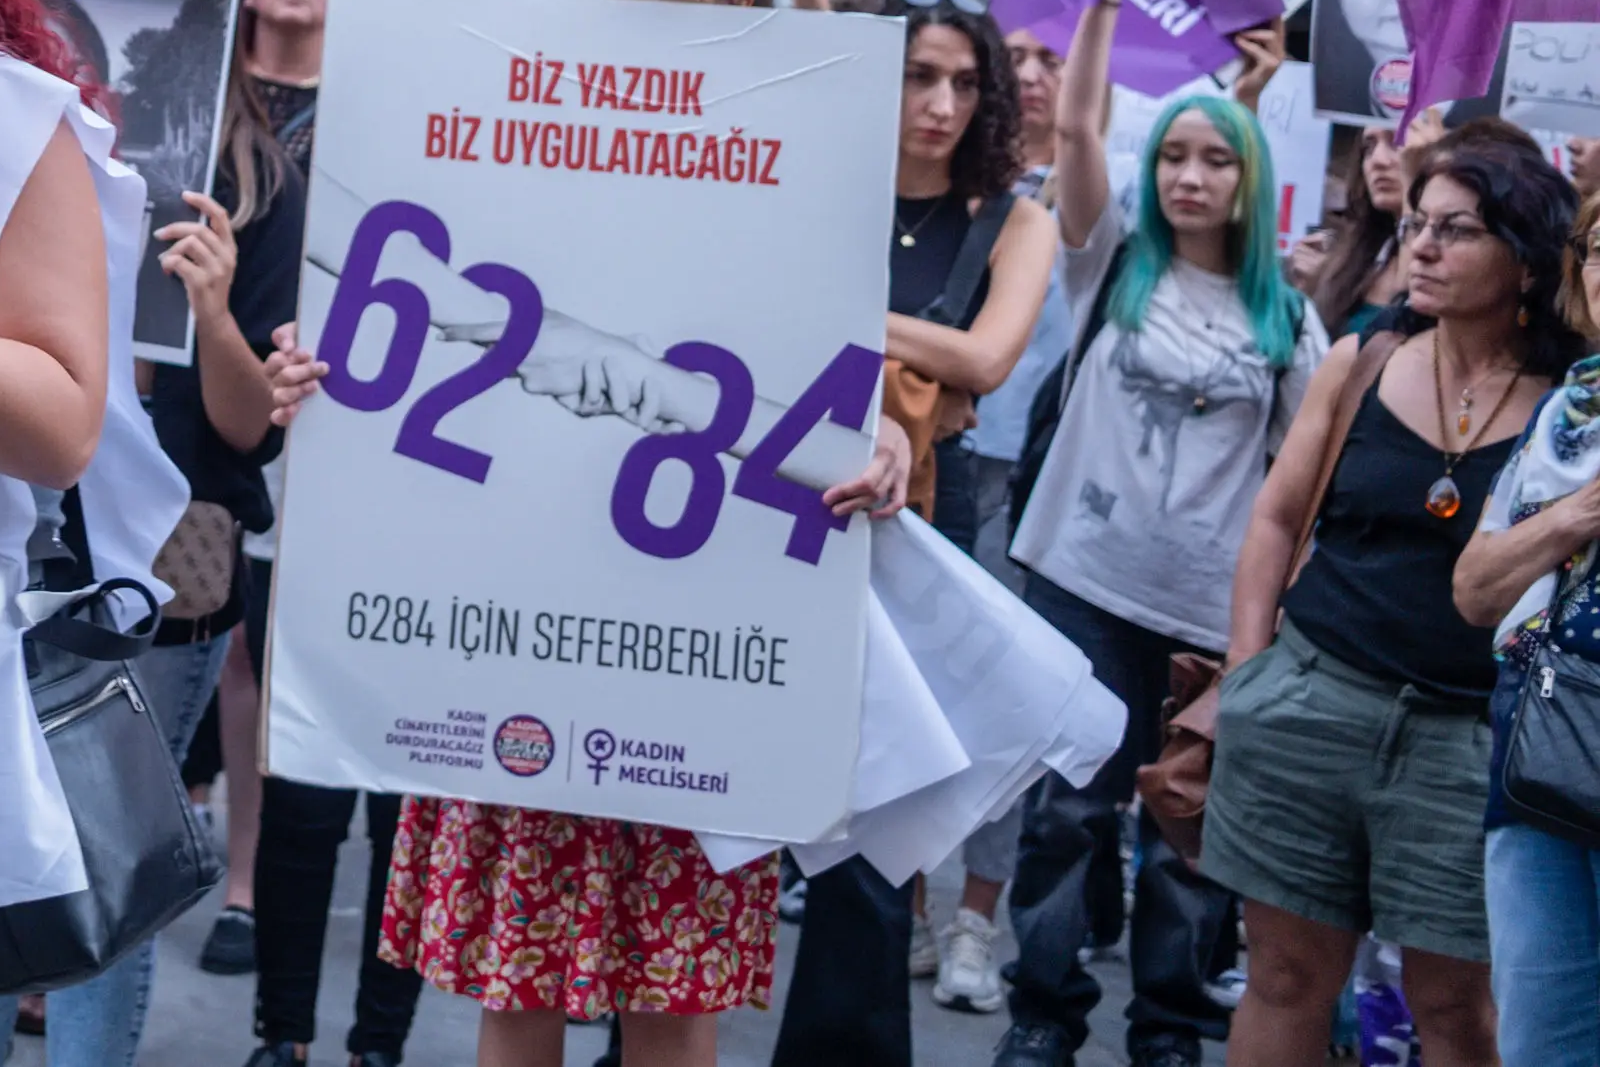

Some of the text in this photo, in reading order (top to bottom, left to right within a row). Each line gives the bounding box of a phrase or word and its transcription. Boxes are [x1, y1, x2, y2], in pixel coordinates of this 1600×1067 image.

[507, 51, 706, 116] BİZ YAZDIK
[425, 107, 782, 186] BİZ UYGULATACAĞIZ
[316, 199, 885, 566] 6284
[347, 591, 789, 687] 6284 İÇİN SEFERBERLİĞE
[447, 709, 487, 723] KADIN
[408, 749, 484, 770] PLATFORMU
[619, 738, 686, 764] KADIN
[617, 765, 730, 795] MECLİSLERİ
